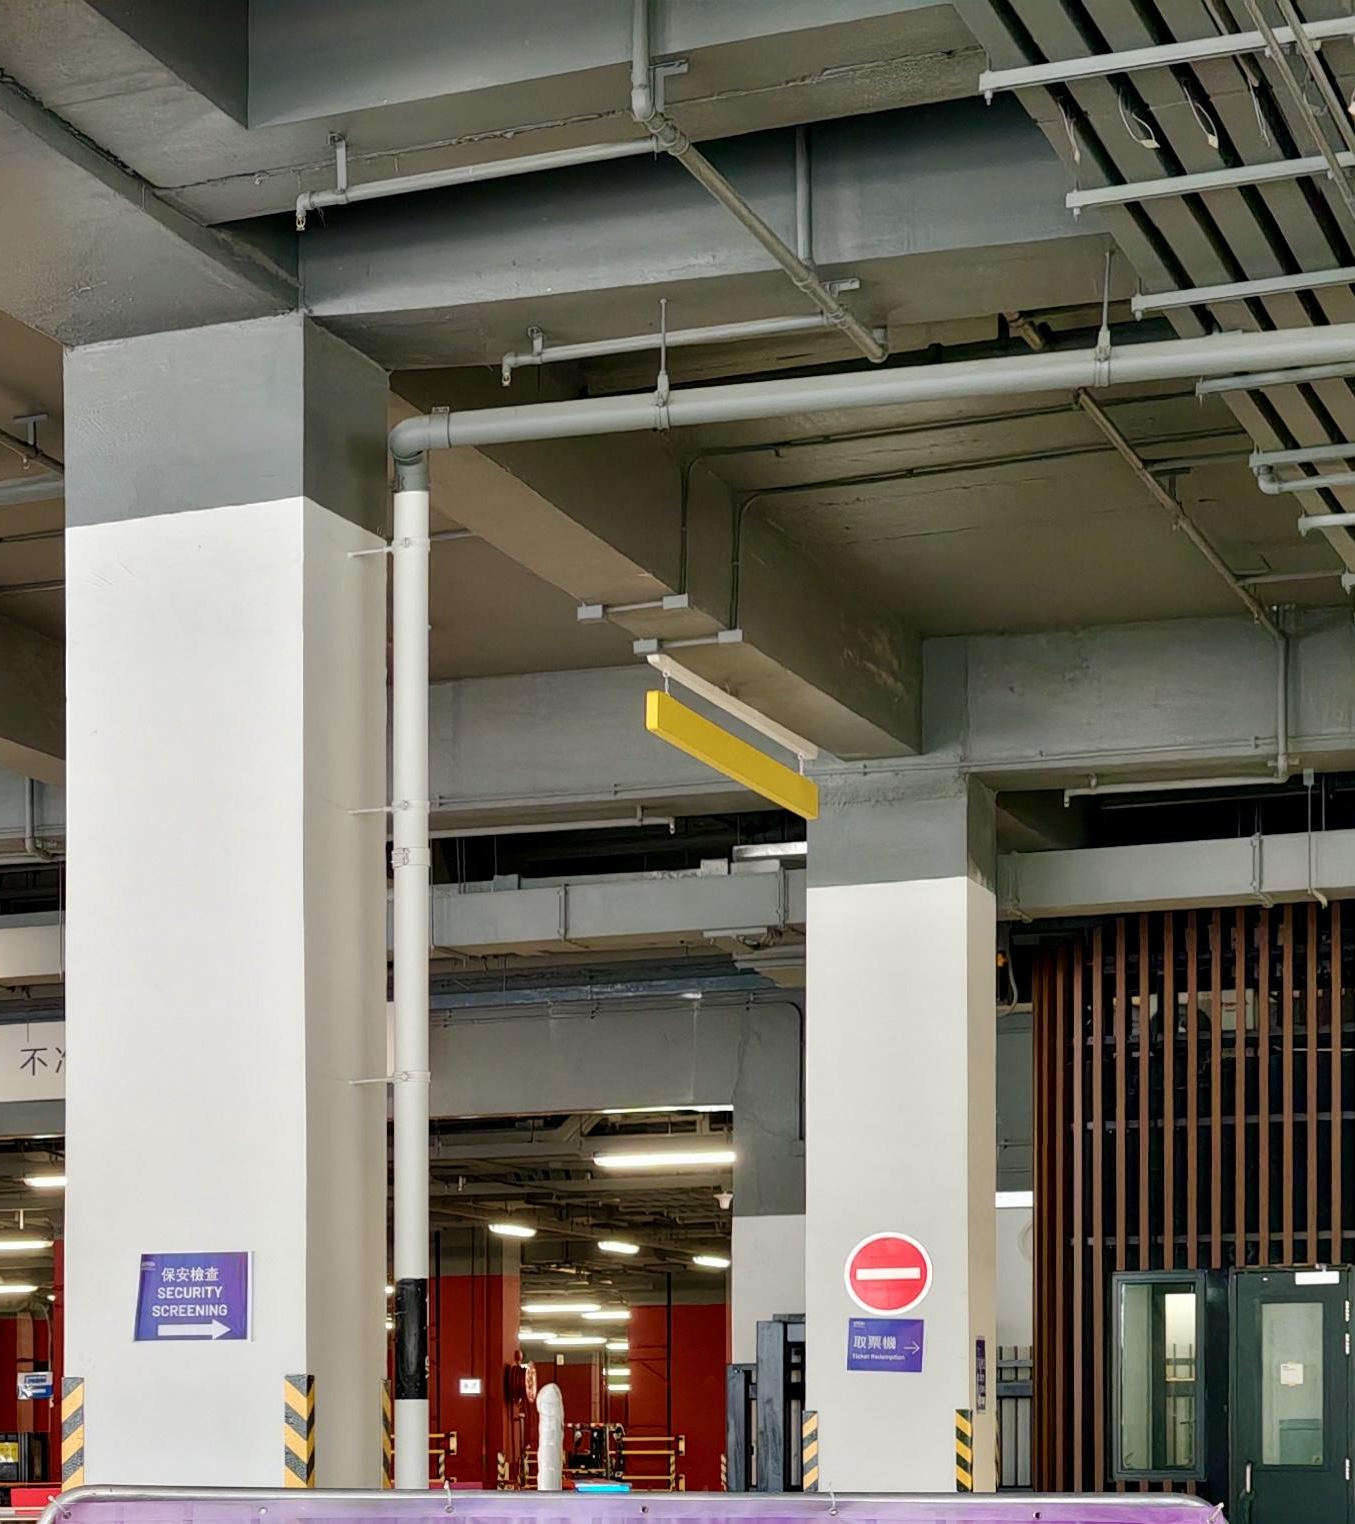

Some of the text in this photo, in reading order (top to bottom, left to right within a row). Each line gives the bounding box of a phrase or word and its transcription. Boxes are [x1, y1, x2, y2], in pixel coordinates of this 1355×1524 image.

[20, 1047, 65, 1076] 不
[161, 1266, 220, 1282] 保安檢查
[157, 1286, 223, 1299] SECURITY
[152, 1304, 228, 1317] SCREENING
